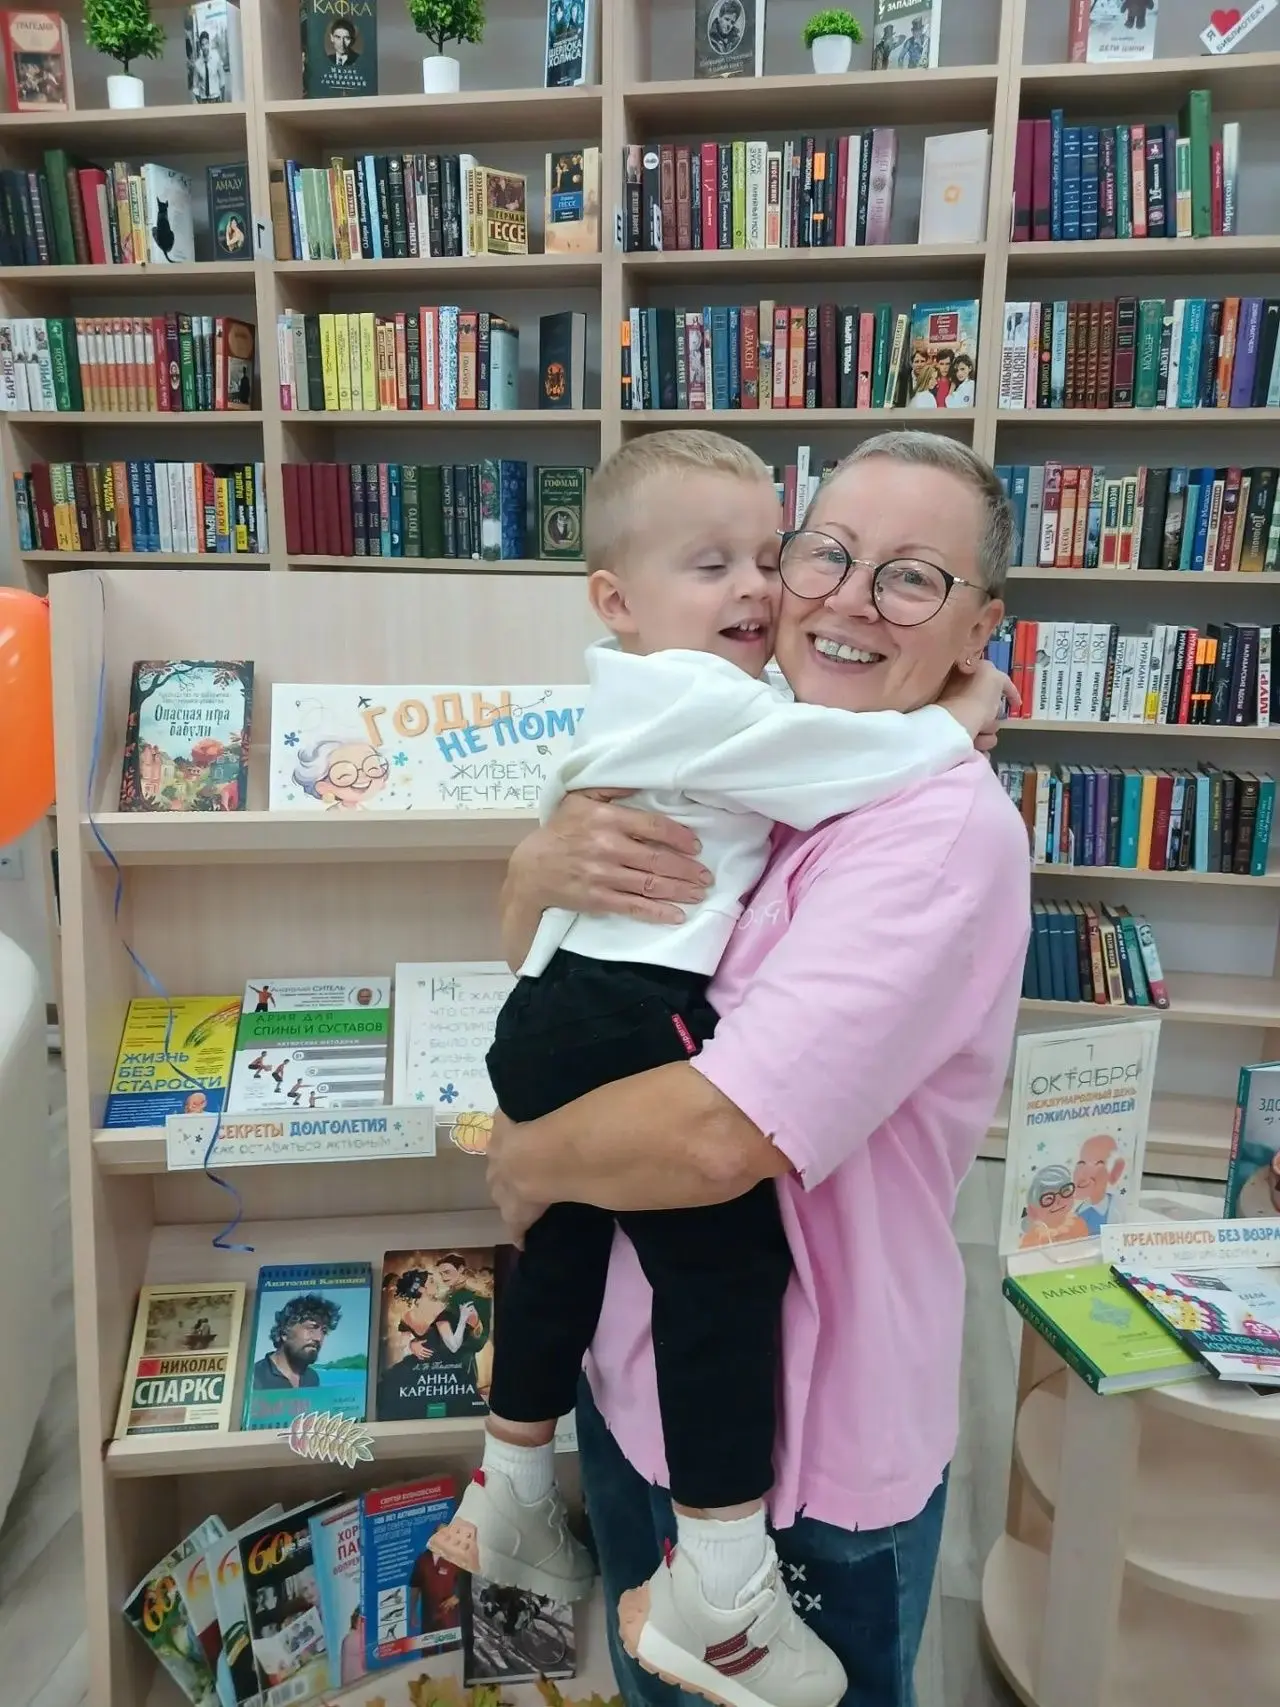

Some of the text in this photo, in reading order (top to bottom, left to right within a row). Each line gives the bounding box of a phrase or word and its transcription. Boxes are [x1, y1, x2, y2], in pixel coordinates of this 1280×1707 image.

[313, 0, 372, 17] КАФКА
[1206, 30, 1216, 41] Я
[1215, 4, 1266, 52] БИБЛИОТЕКУ
[215, 178, 243, 192] АМАДУ
[721, 166, 730, 192] ЗУСАК
[495, 210, 525, 222] ГЕРМАН
[1223, 179, 1233, 232] Моррисон
[488, 219, 526, 243] ГЕССЕ
[744, 327, 753, 370] ДРАКОН
[1143, 334, 1154, 370] МОЛЬЕР
[7, 356, 15, 399] БАРНС
[42, 356, 51, 401] БАРНС
[1001, 351, 1012, 397] МАКЬЮЭН
[1011, 351, 1026, 401] МАКЬЮЭН
[544, 479, 578, 487] ГОФМАН
[1126, 485, 1135, 505] МОЭМ
[1109, 487, 1118, 507] МОЭМ
[216, 486, 225, 534] ЛЮБИТЬ
[1061, 527, 1070, 554] МОЭМ
[1055, 630, 1069, 664] 1Q84
[1073, 632, 1088, 664] 1Q84
[1091, 633, 1107, 664] 1Q84
[1176, 632, 1186, 670] МУРАКАМИ
[1186, 633, 1197, 670] МУРАКАМИ
[1113, 641, 1125, 689] МУРАКАМИ
[1137, 641, 1149, 689] МУРАКАМИ
[155, 703, 230, 726] Опасная игра
[360, 690, 512, 747] ГОДЫ
[169, 721, 212, 741] бабули
[435, 707, 585, 763] НЕ ПОМ
[312, 984, 346, 992] СИТЕЛЬ
[472, 991, 508, 1000] ЖАЛЕ
[255, 1012, 334, 1023] АРИЯ ДЛЯ
[430, 1008, 456, 1017] ЧТО
[253, 1022, 383, 1036] СПИНЫ И СУСТАВОВ
[429, 1038, 467, 1048] БЫЛО
[1086, 1044, 1094, 1061] 1
[122, 1052, 190, 1065] ЖИЗНЬ
[118, 1065, 156, 1078] БЕЗ
[430, 1069, 439, 1078] А
[1030, 1064, 1141, 1095] ОКТЯБРЯ
[116, 1076, 222, 1092] СТАРОСТИ
[1026, 1086, 1138, 1111] МЕЖДУНАРОДНЫЙ ДЕНЬ
[1026, 1098, 1136, 1126] ПОЖИЛЫХ ЛЮДЕЙ
[217, 1118, 387, 1139] СЕКРЕТЫ ДОЛГОЛЕТИЯ
[1122, 1229, 1216, 1248] КРЕАТИВНОСТЬ
[1217, 1230, 1241, 1243] БЕЗ
[160, 1358, 225, 1374] НИКОЛАС
[134, 1376, 223, 1405] СПАРКС
[417, 1372, 458, 1385] АННА
[400, 1384, 476, 1398] КАРЕНИНА
[248, 1531, 292, 1575] 60
[143, 1575, 176, 1632] 60
